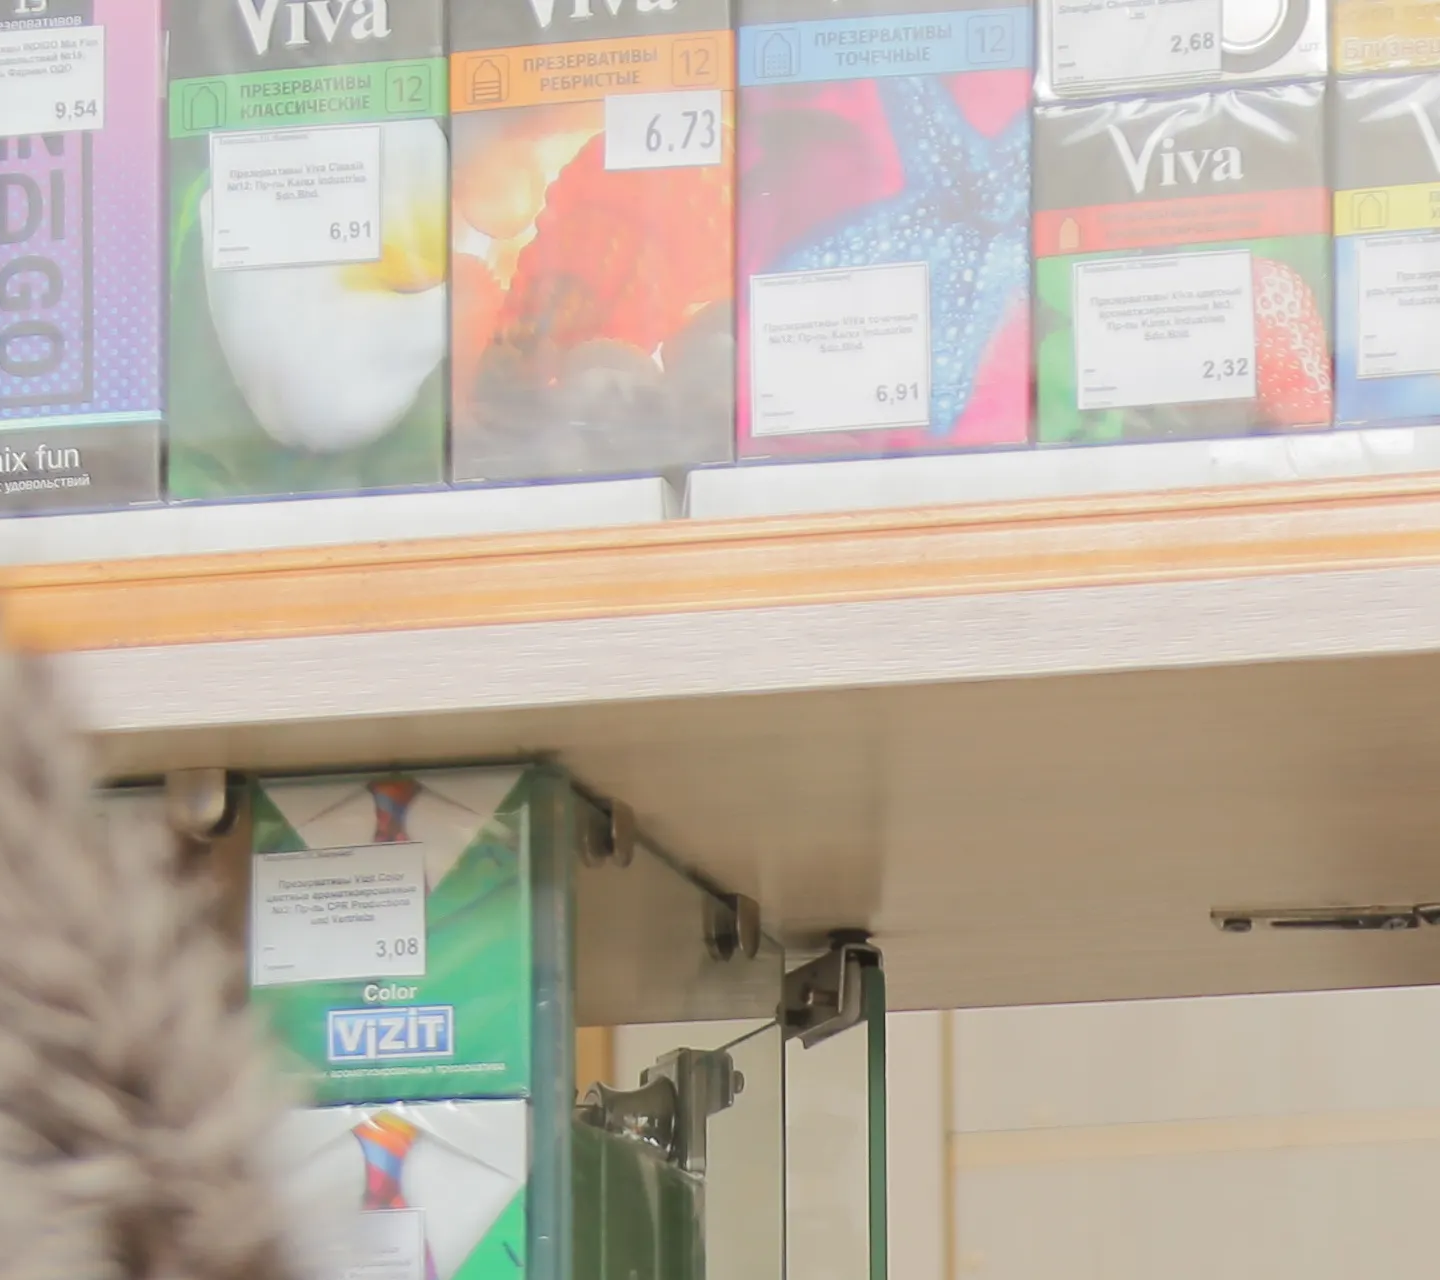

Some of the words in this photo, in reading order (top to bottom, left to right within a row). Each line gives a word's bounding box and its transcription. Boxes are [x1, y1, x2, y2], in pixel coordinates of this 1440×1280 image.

[237, 0, 392, 56] Viva
[814, 22, 953, 47] ПРЕЗЕРВАТИВЫ
[974, 25, 1007, 53] 12
[1170, 32, 1216, 55] 2,68
[522, 47, 658, 73] ПРЕЗЕРВАТИВЫ
[677, 48, 711, 78] 12
[834, 46, 931, 67] ТОЧЕЧНЫЕ
[240, 74, 372, 99] ПРЕЗЕРВАТИВЫ
[391, 75, 424, 103] 12
[539, 70, 642, 92] РЕБРИСТЫЕ
[54, 100, 98, 122] 9,54
[240, 95, 371, 120] КЛАССИЧЕСКИЕ
[644, 108, 717, 153] 6.73
[1107, 112, 1244, 194] Viva
[329, 221, 372, 242] 6,91
[1201, 358, 1250, 382] 2,32
[875, 381, 920, 405] 6,91
[35, 445, 81, 472] fun
[4, 473, 91, 494] удовольствий
[375, 937, 419, 961] 3,08
[363, 983, 418, 1002] Color
